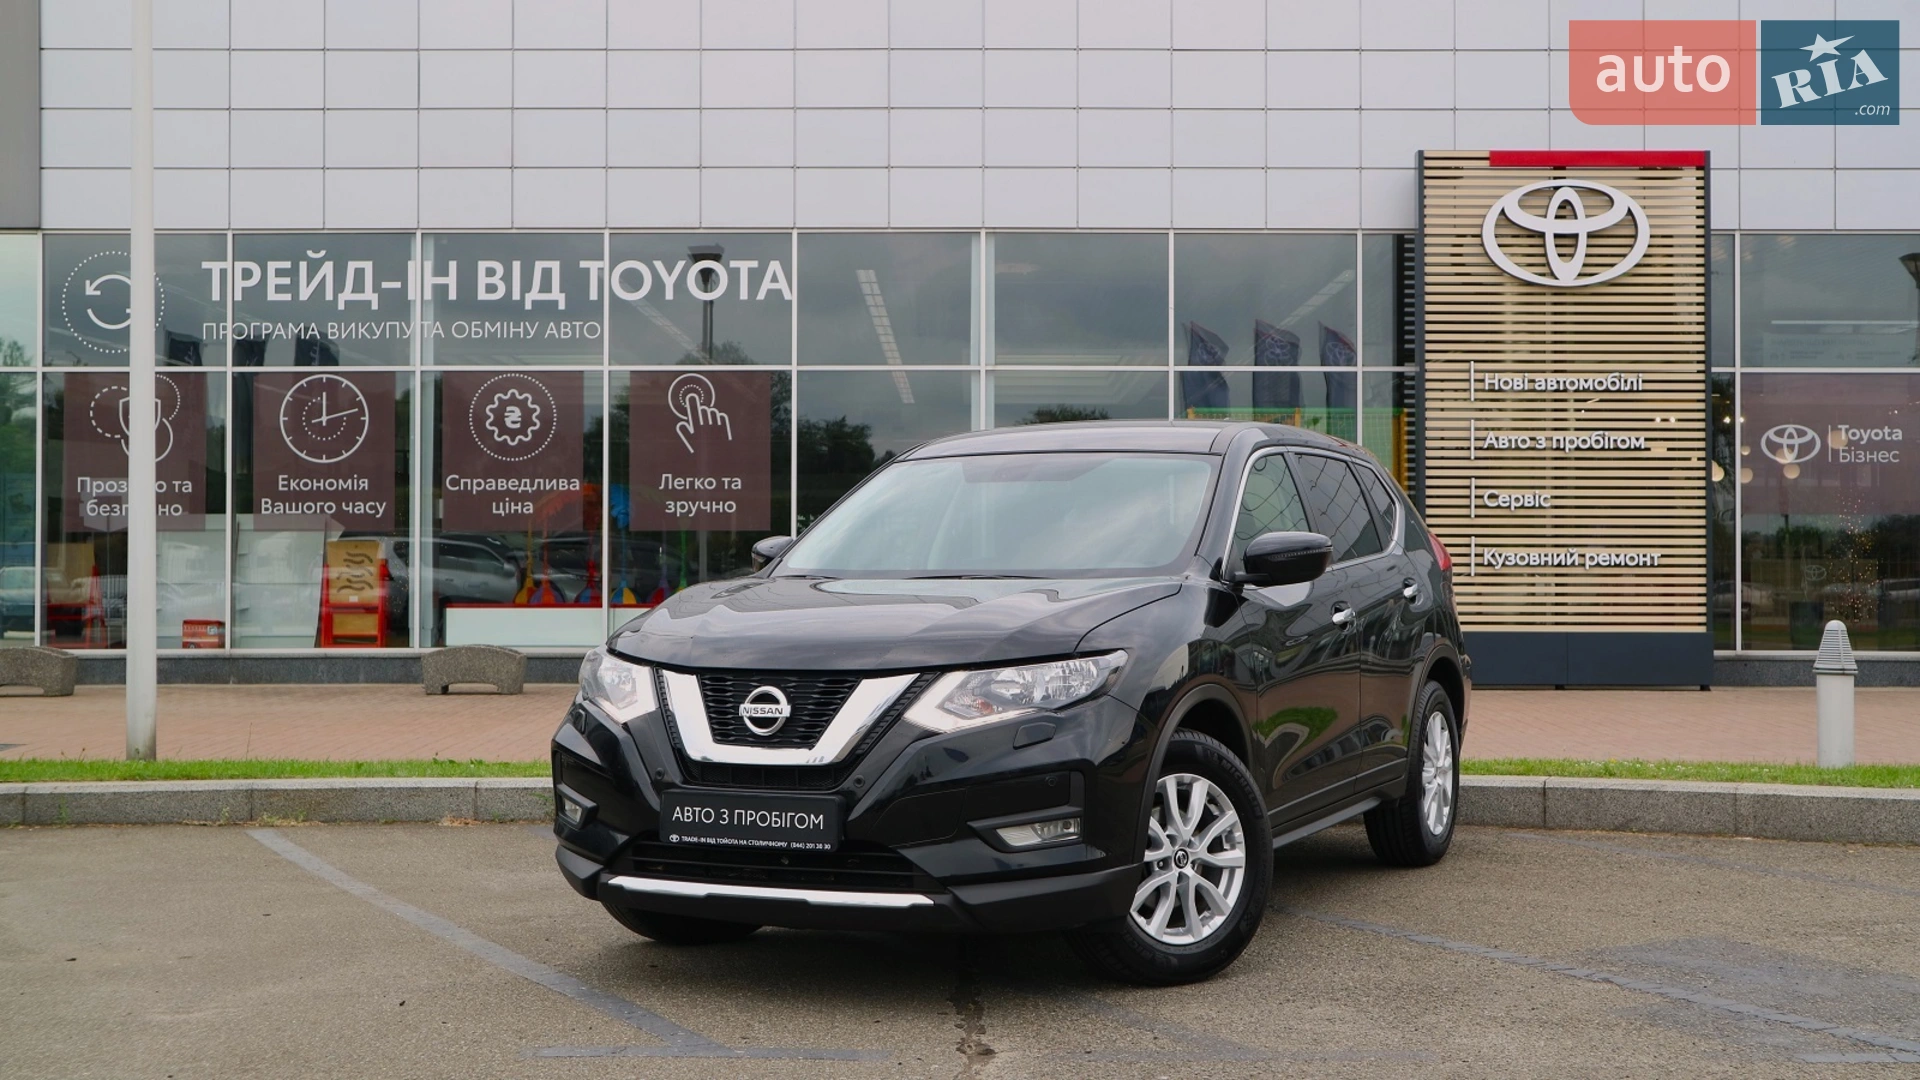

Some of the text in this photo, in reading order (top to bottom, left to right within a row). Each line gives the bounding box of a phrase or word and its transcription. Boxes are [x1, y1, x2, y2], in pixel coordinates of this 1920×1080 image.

[202, 250, 793, 311] ТРЕЙД-ІН ВІД TOYOTA
[204, 320, 601, 340] ПРОГРАМА ВИКУПУ ТА ОБМІНУ АВТО
[1484, 372, 1643, 391] Нові автомобілі
[1483, 431, 1645, 453] Авто з пробігом
[1838, 425, 1902, 445] Toyota
[1840, 447, 1900, 463] Бізнес
[77, 476, 192, 496] Прозо та
[278, 474, 369, 491] Економія
[445, 474, 580, 493] Справедлива
[659, 473, 742, 490] Легко та
[261, 499, 386, 518] Вашого часу
[492, 498, 534, 517] ціна
[665, 499, 737, 518] зручно
[1483, 490, 1552, 511] Сервіс
[1483, 548, 1661, 569] Кузовний ремонт
[742, 706, 784, 715] NISSAN
[672, 806, 715, 824] АВТО
[734, 810, 824, 830] ПРОБІГОМ
